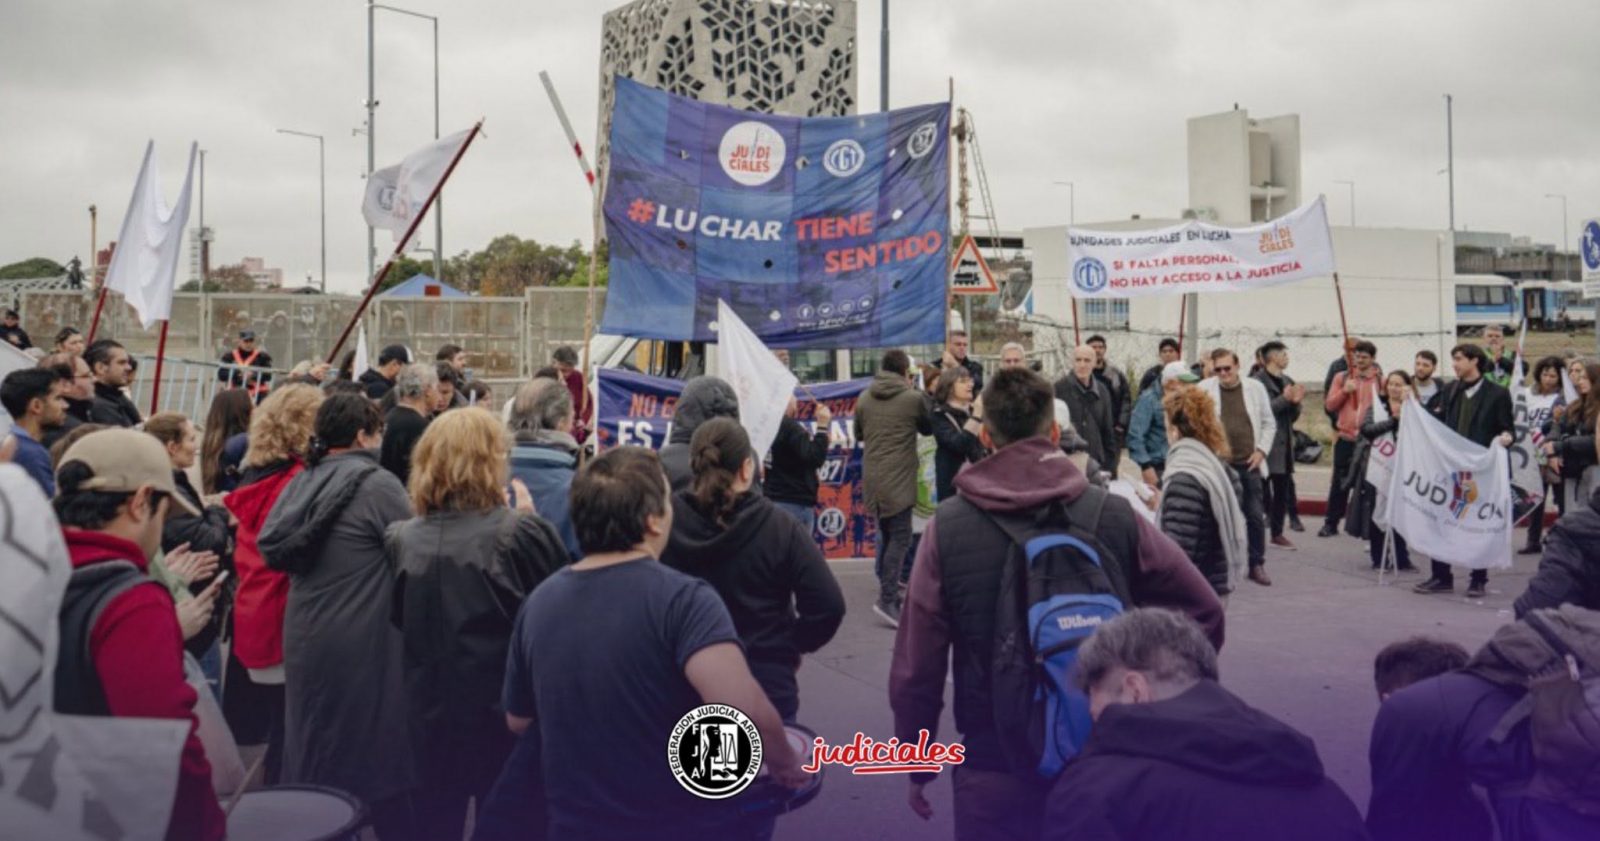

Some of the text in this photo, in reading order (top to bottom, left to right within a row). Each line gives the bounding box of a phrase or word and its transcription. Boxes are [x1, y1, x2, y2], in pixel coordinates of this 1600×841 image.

[627, 197, 874, 241] #LUCHAR TIENE
[1126, 232, 1181, 246] JUDICIALES
[1186, 229, 1200, 241] EN
[1203, 229, 1232, 242] LUCHA
[824, 230, 942, 273] SENTIDO
[1113, 260, 1124, 270] SI
[1129, 258, 1169, 270] FALTA
[1109, 260, 1302, 288] NO HAY ACCESO A LA JUSTICIA
[629, 393, 657, 418] NO
[616, 421, 653, 449] ES
[1057, 613, 1102, 630] Wilson
